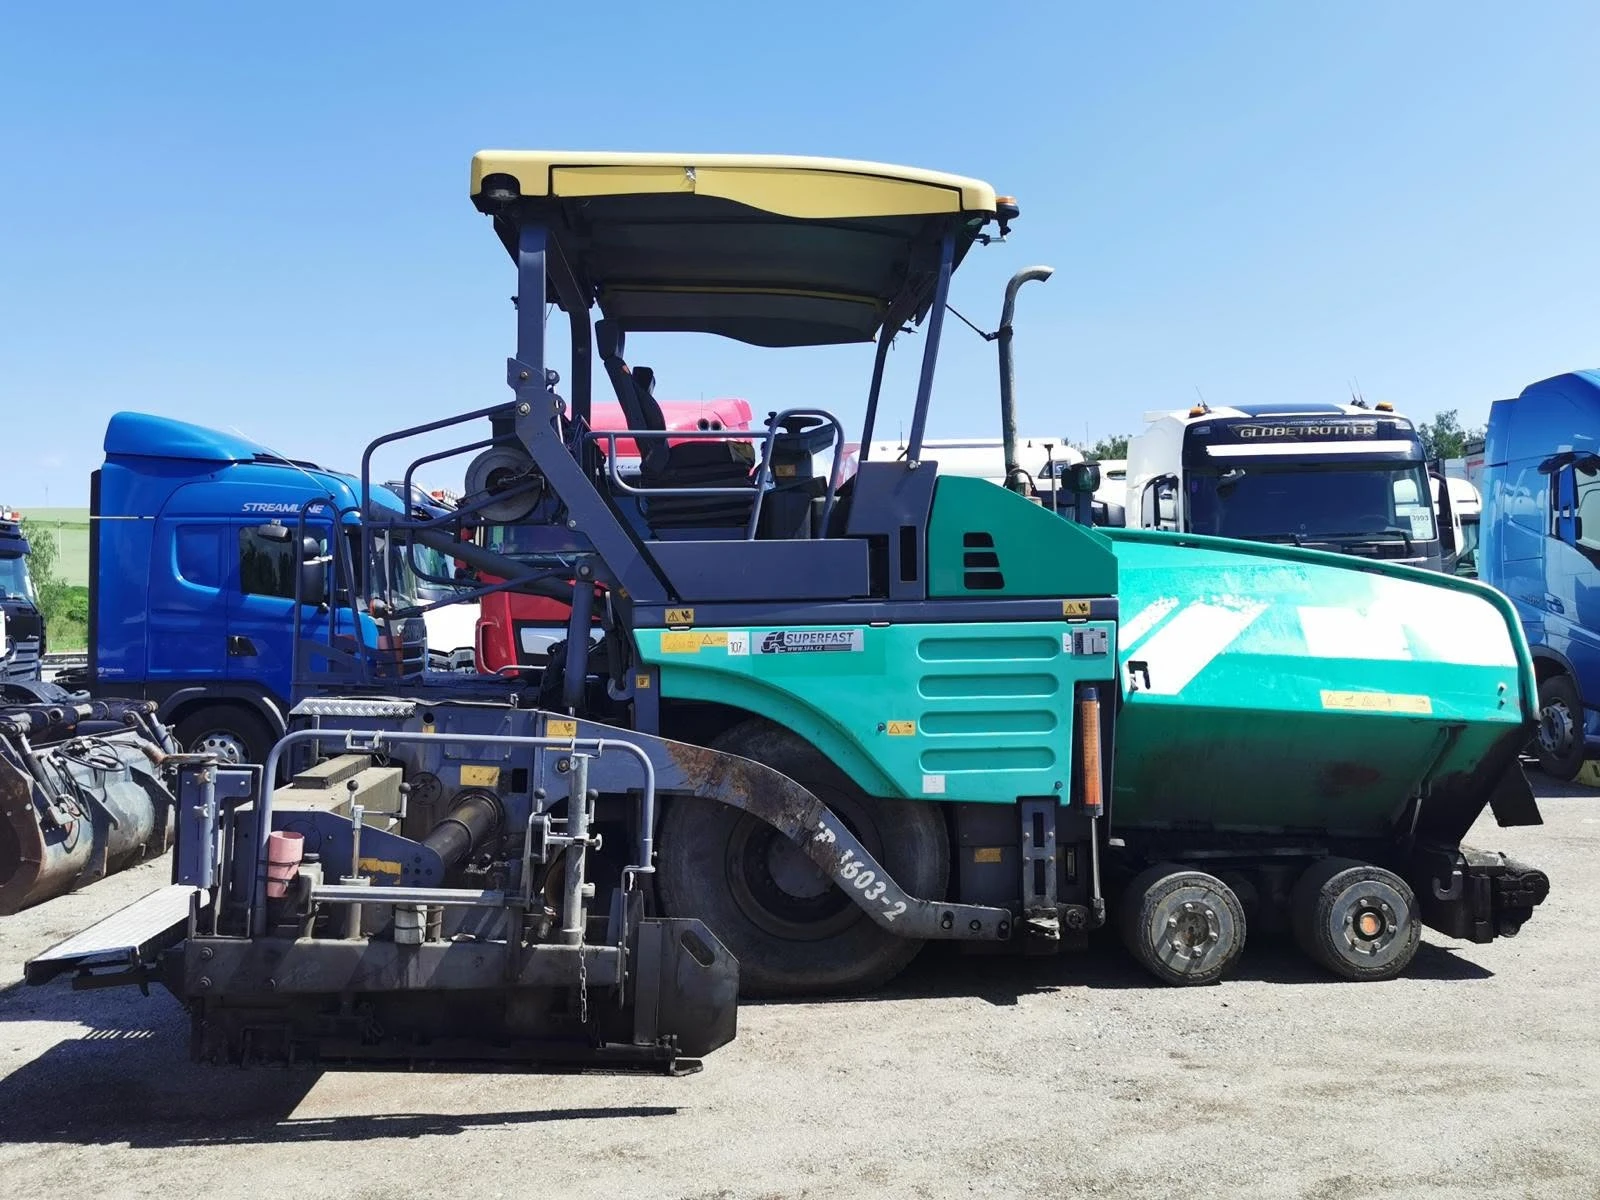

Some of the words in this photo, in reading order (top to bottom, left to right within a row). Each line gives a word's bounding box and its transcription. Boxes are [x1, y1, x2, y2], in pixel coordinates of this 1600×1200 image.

[1240, 426, 1375, 438] GLOBETROTTER
[242, 502, 324, 514] STREAMLNE
[785, 632, 854, 645] SUPERFAST
[840, 849, 907, 922] 1603-2
